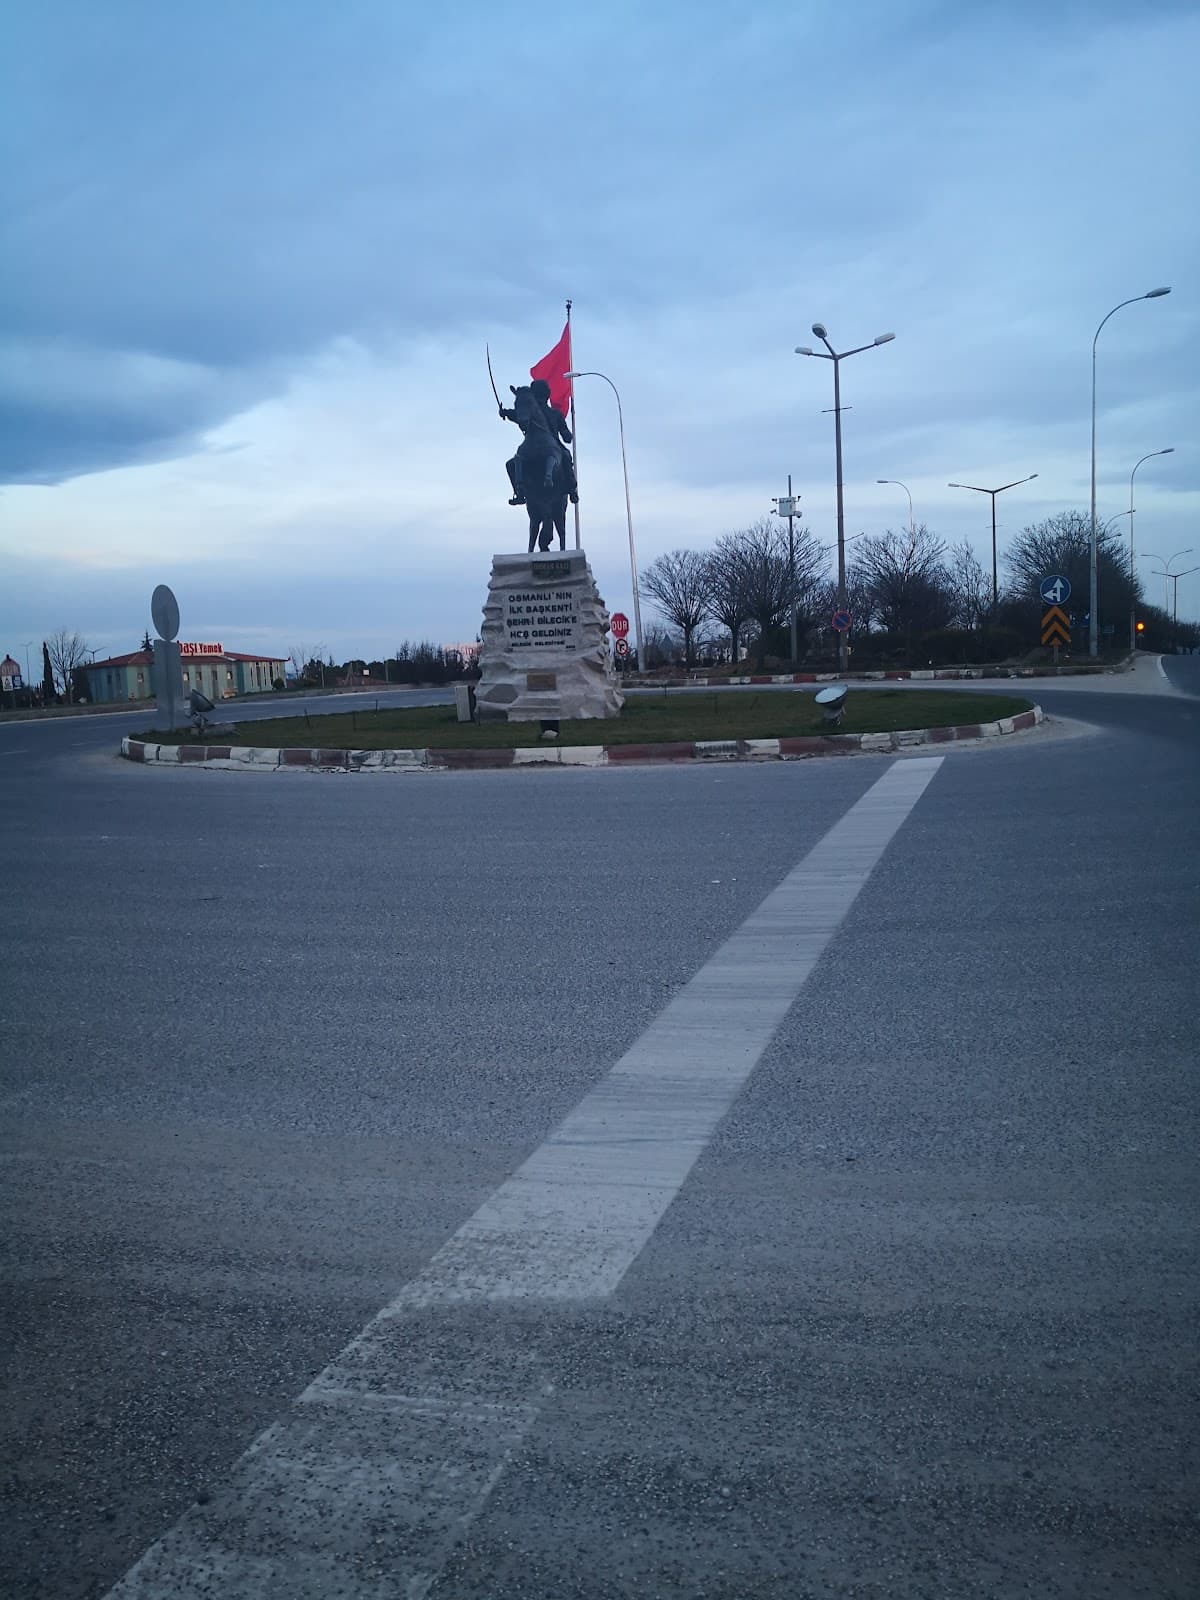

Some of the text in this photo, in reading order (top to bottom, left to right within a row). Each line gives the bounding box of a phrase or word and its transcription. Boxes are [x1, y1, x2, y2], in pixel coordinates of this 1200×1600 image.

[526, 603, 572, 614] BAŞKENTİ
[612, 620, 628, 631] DUR
[532, 628, 572, 638] GELDİNİZ
[199, 643, 222, 654] Yemek
